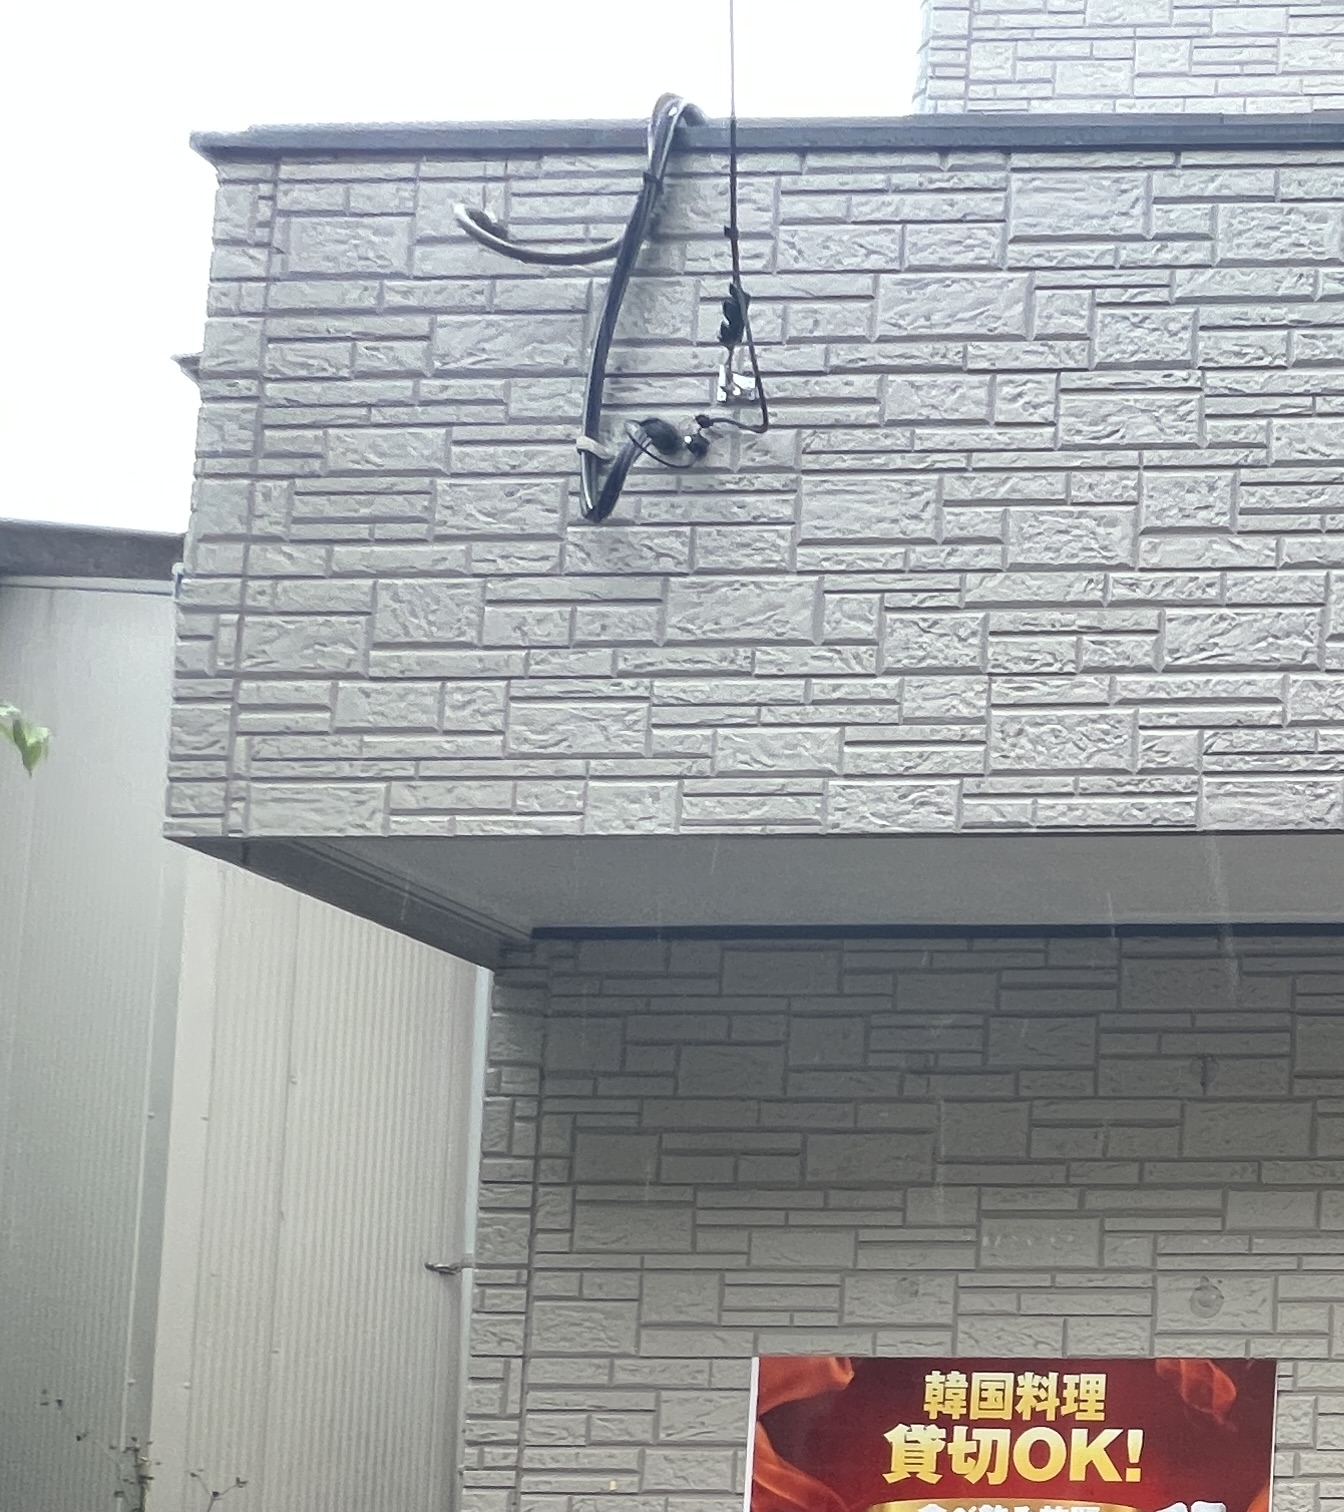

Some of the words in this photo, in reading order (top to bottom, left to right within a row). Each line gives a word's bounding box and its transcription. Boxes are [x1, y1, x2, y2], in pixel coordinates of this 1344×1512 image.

[923, 1371, 1107, 1422] 韓国料理
[883, 1422, 1145, 1485] 貸切OK!
